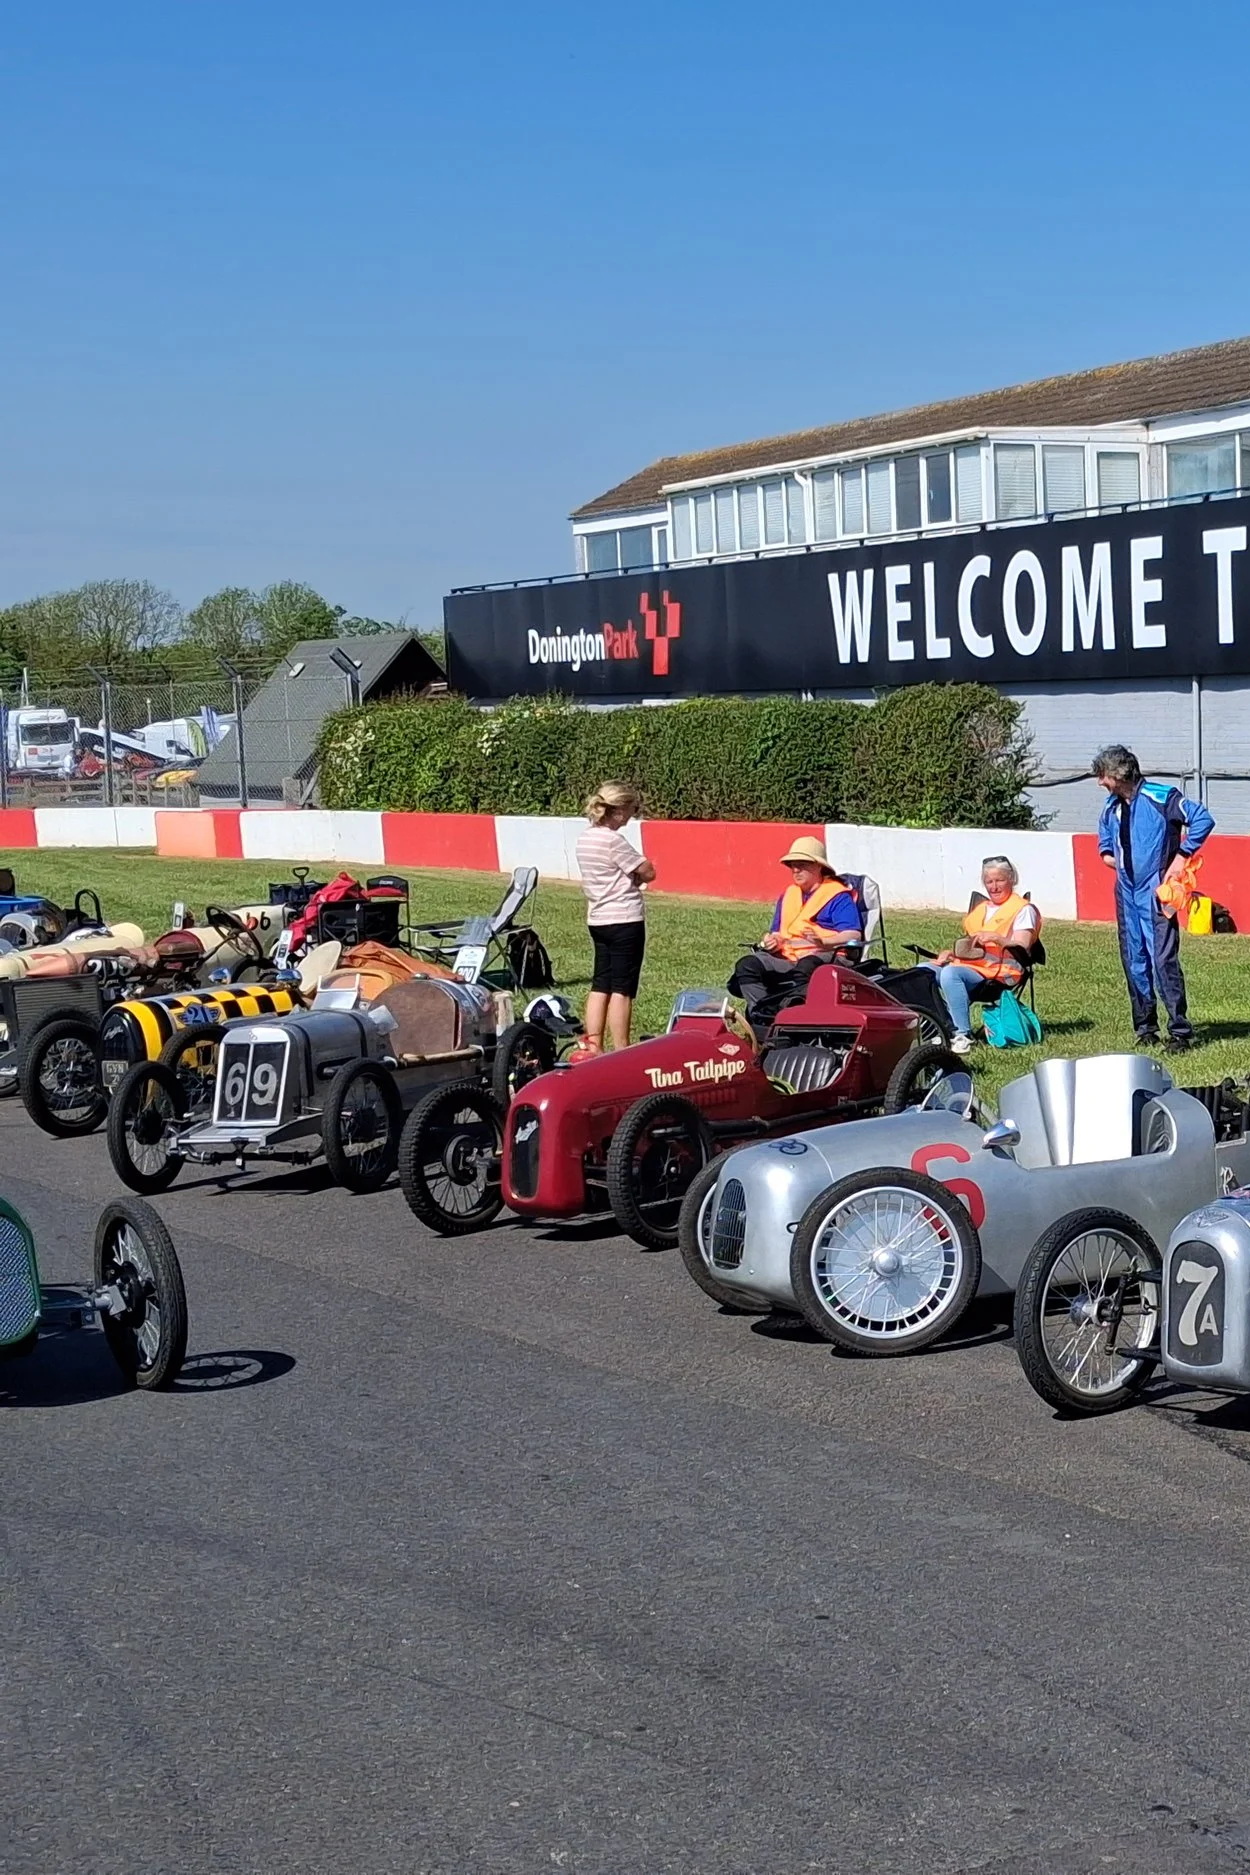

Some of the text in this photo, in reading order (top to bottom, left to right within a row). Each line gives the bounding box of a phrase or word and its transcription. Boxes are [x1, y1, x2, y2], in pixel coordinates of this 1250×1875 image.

[827, 535, 1168, 664] WELCOME
[224, 1062, 277, 1106] 69
[644, 1058, 746, 1089] Tina Tailpipe
